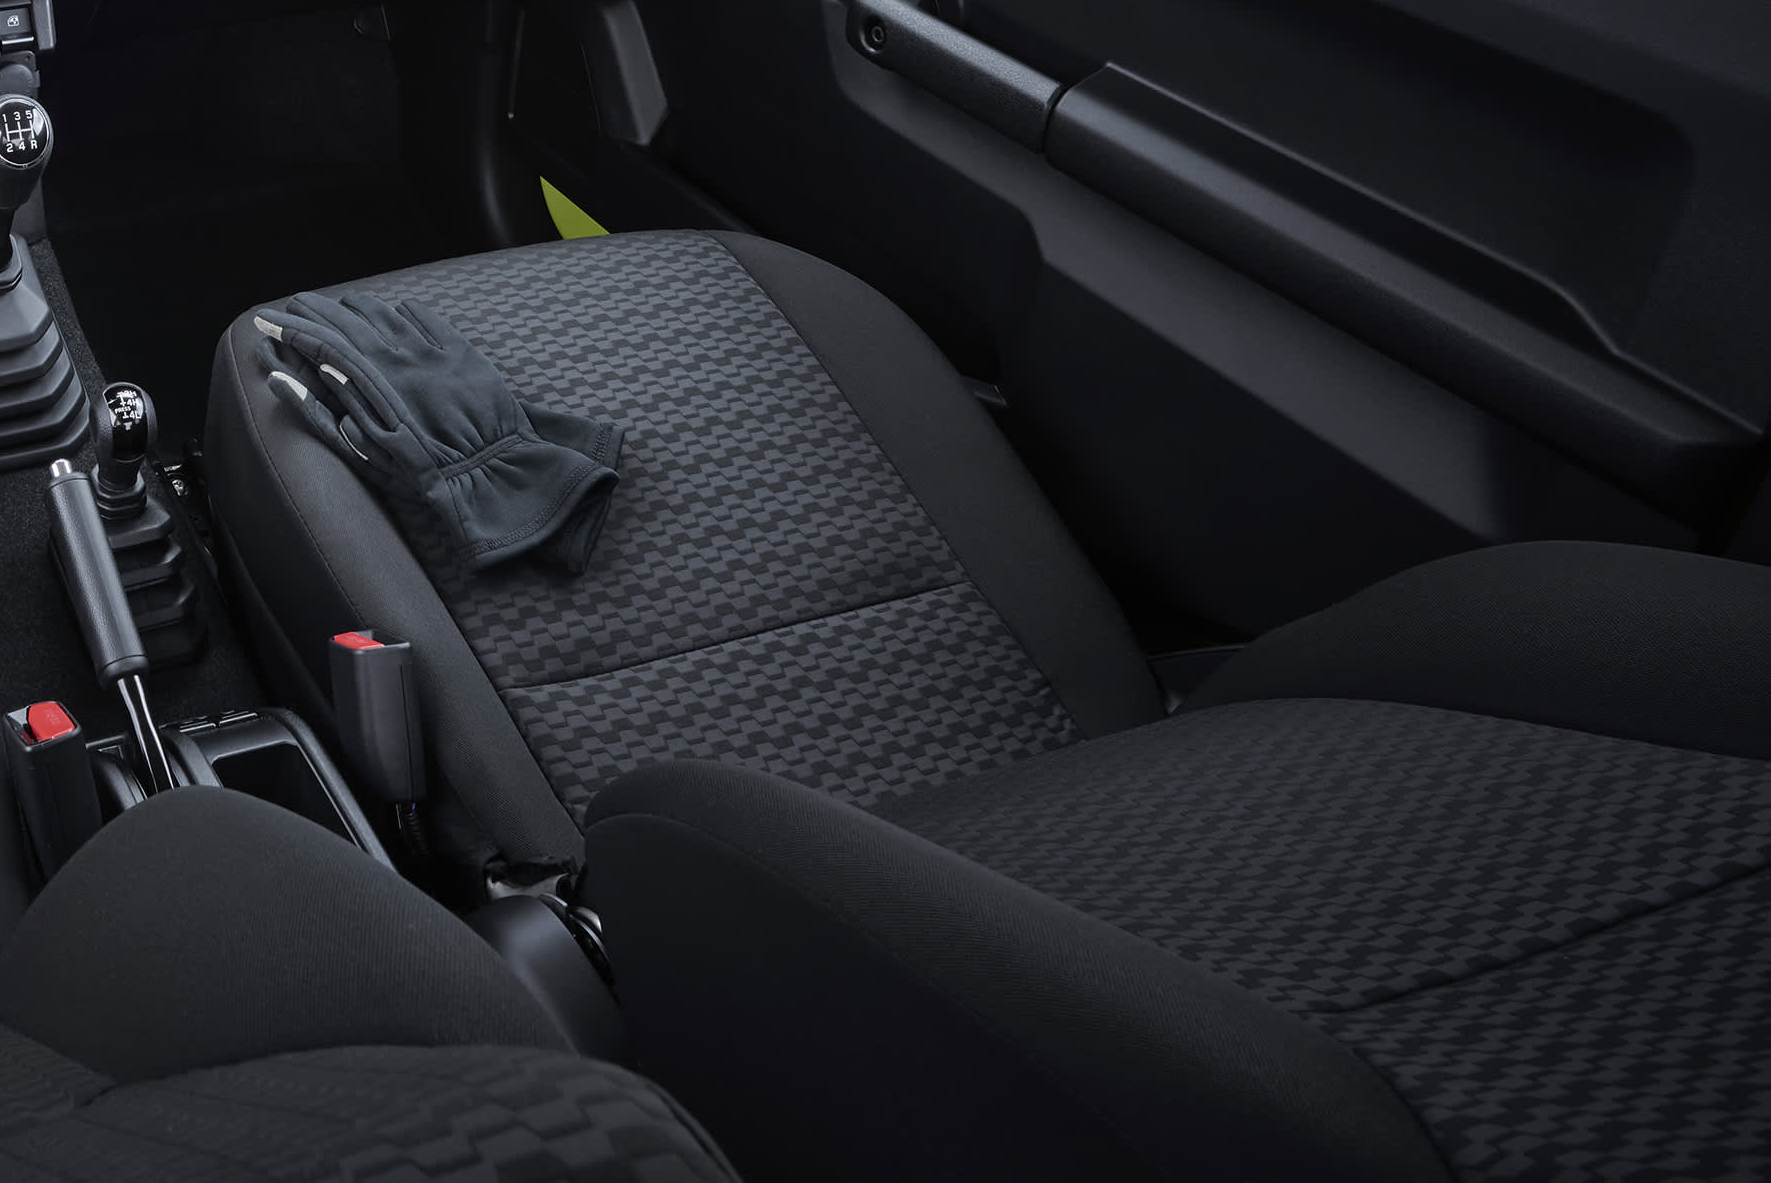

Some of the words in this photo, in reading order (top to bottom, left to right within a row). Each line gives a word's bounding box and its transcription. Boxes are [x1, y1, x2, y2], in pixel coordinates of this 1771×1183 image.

[2, 114, 6, 122] 1
[14, 112, 21, 120] 3
[25, 110, 32, 119] 5
[6, 143, 13, 152] 2
[19, 141, 25, 150] 4
[31, 140, 37, 149] R
[130, 411, 141, 419] 4L
